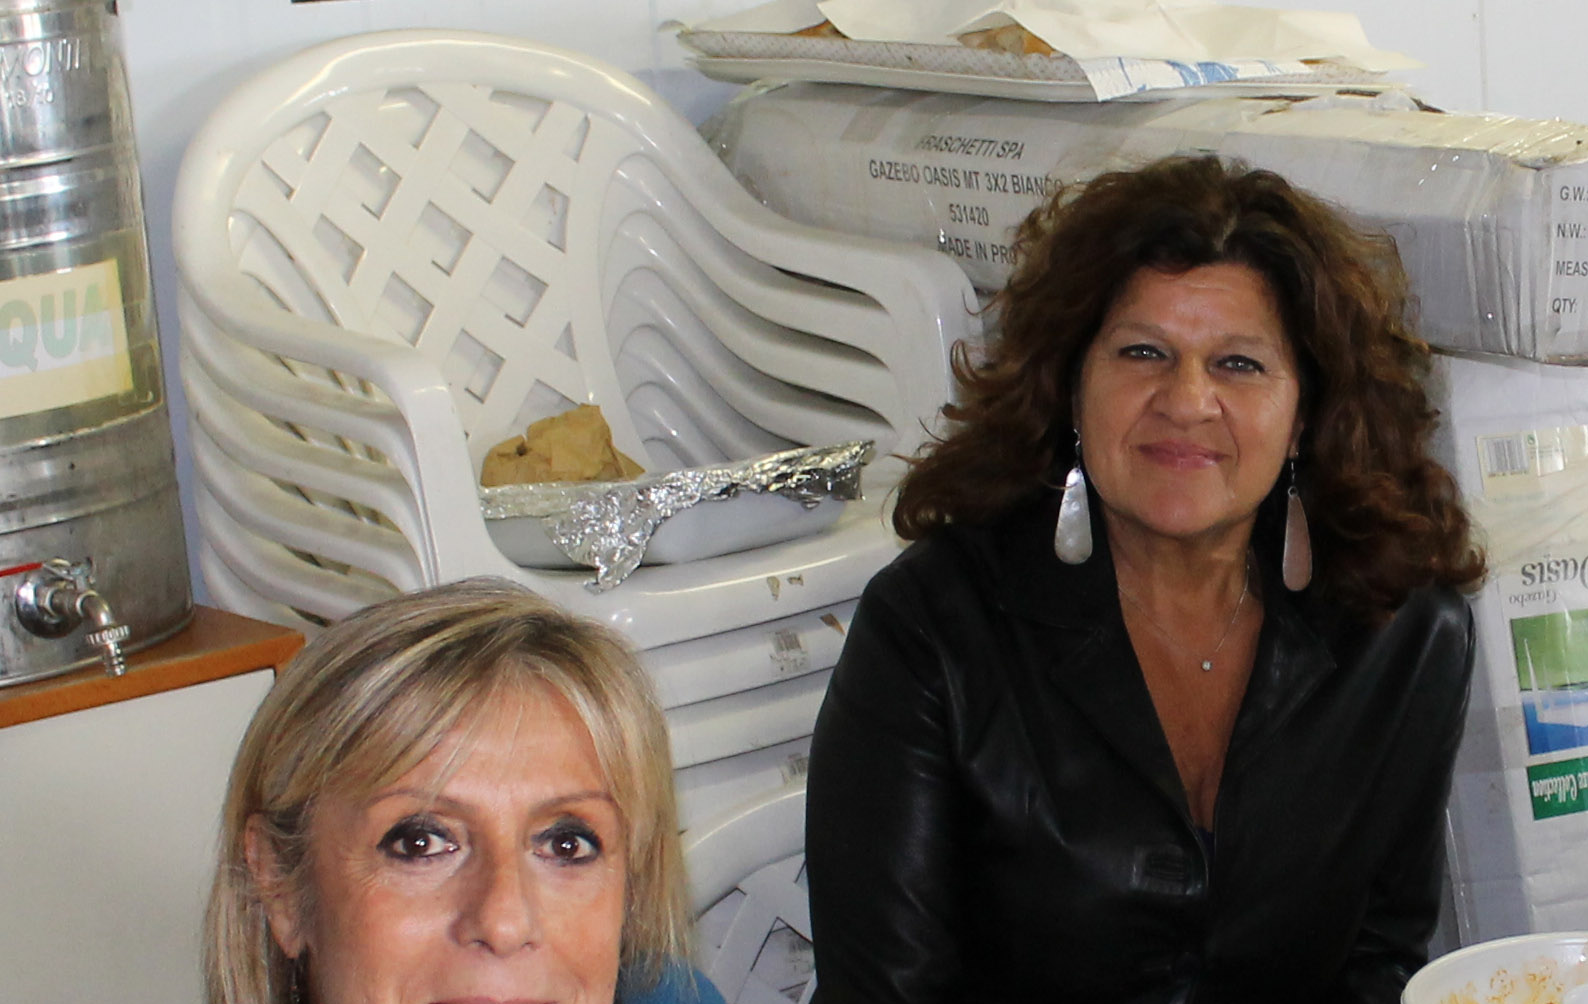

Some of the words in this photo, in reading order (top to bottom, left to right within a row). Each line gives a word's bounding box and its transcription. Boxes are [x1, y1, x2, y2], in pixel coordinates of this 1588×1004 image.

[997, 141, 1026, 160] SPA
[869, 159, 920, 183] GAZEBO
[923, 165, 961, 188] OASIS
[962, 171, 980, 191] MT
[985, 172, 1009, 193] 3X2
[1012, 174, 1064, 198] BIANCO
[949, 204, 989, 226] 531420
[938, 235, 972, 259] MADE
[975, 240, 988, 261] IN
[1508, 590, 1557, 608] Gazebo
[1532, 773, 1578, 803] Collection
